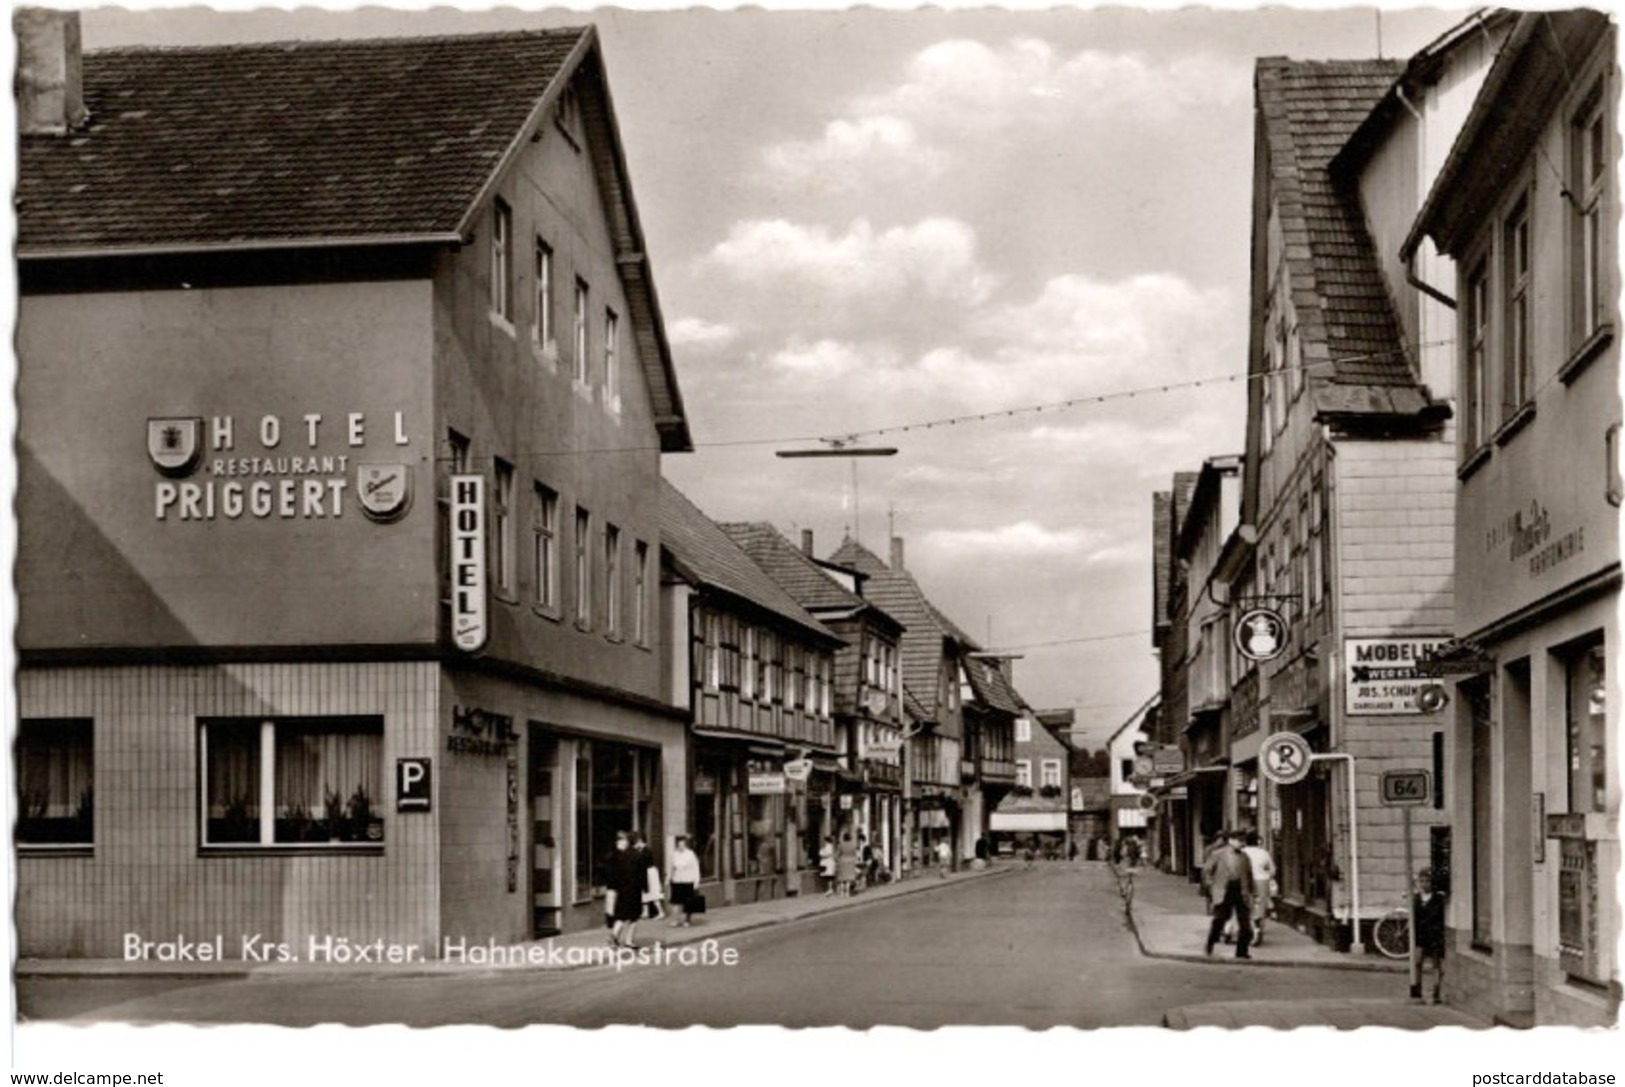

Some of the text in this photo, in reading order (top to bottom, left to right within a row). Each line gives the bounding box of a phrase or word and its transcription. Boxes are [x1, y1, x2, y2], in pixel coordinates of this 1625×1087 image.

[212, 411, 409, 449] HOTEL
[213, 455, 349, 476] RESTAURANT
[155, 478, 347, 519] PRIGGERT
[456, 481, 478, 614] HOTEL
[453, 704, 520, 742] HOTEL
[403, 762, 425, 793] P
[1394, 779, 1418, 796] 64
